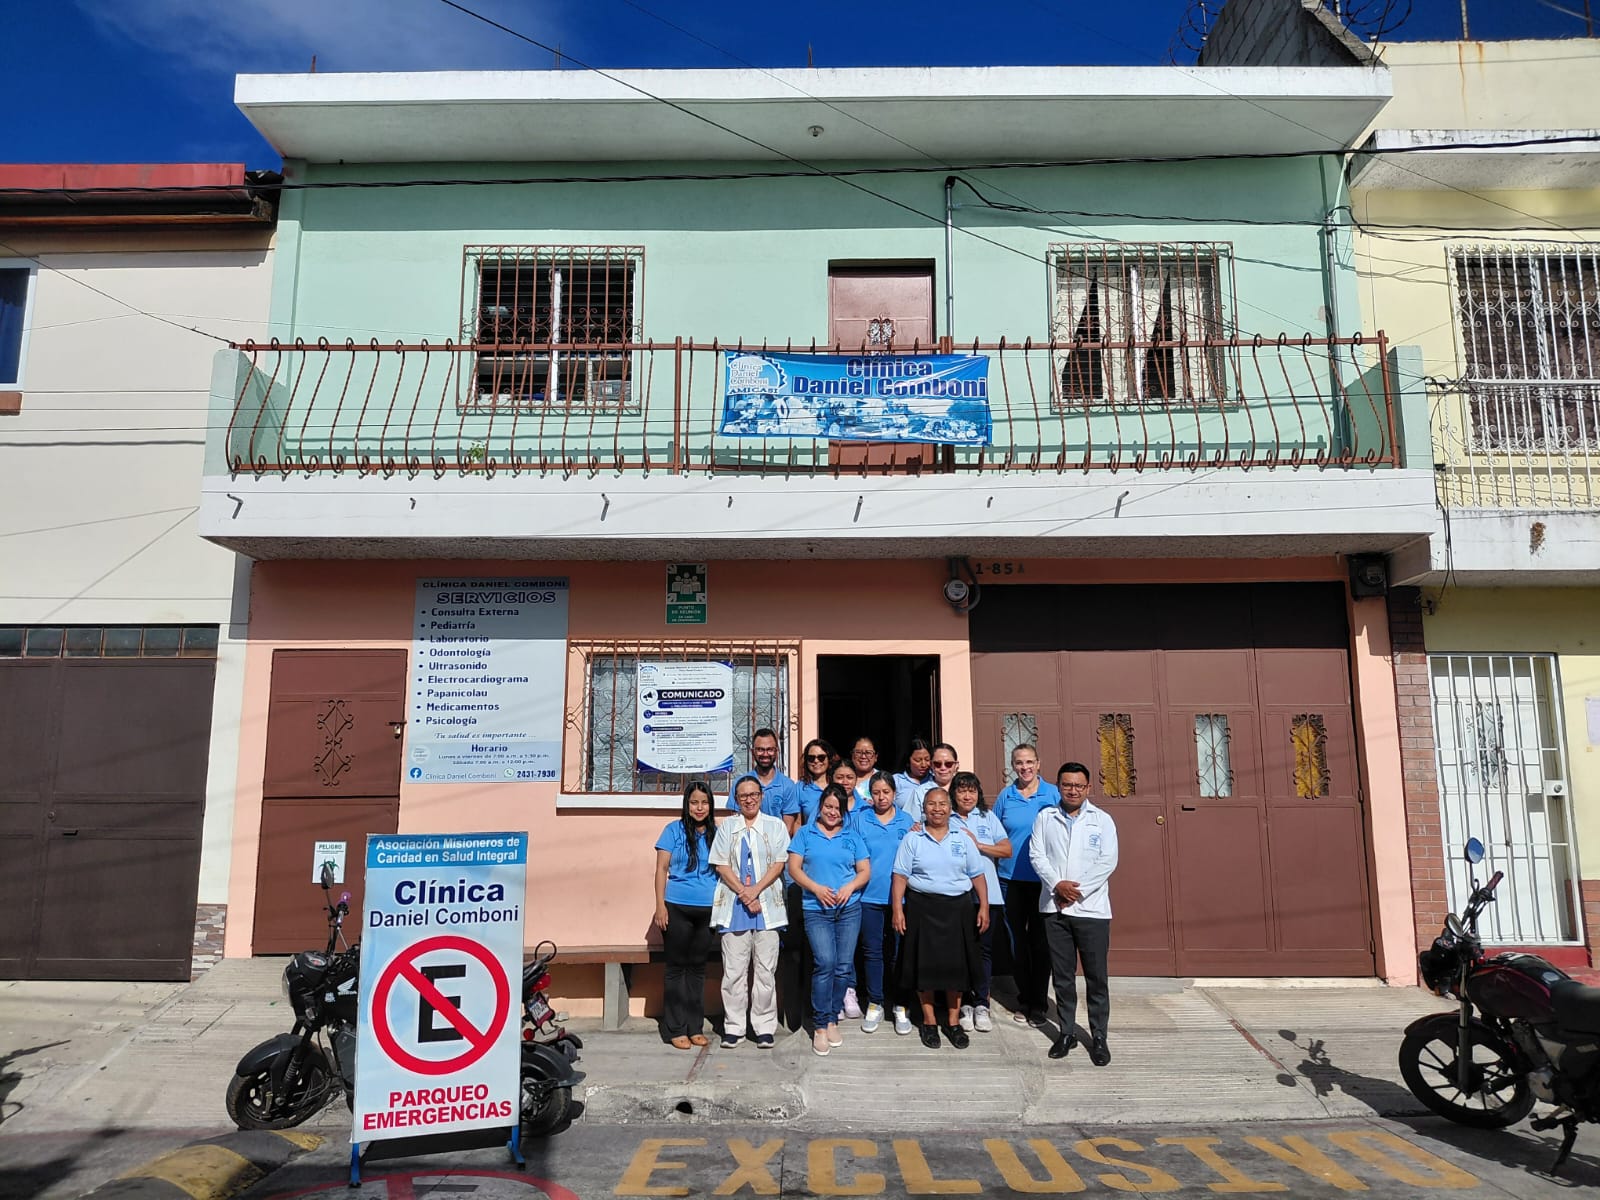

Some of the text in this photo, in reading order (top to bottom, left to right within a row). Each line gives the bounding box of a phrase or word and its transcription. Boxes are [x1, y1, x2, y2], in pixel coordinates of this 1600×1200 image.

[847, 357, 932, 378] Clínica
[793, 376, 986, 397] Daniel Comboni
[422, 580, 467, 588] CLÍNICA
[436, 591, 557, 604] SERVICIOS
[431, 607, 519, 616] Consulta Externa
[430, 620, 476, 630] Pediatría
[430, 634, 490, 643] Laboratorio
[429, 647, 491, 658] Odontología
[428, 661, 488, 670] Ultrasonido
[427, 674, 529, 685] Electrocardiograma
[427, 688, 488, 699] Papanicolau
[661, 690, 722, 699] COMUNICADO
[426, 702, 500, 711] Medicamentos
[425, 715, 477, 726] Psicología
[482, 732, 527, 740] importante
[471, 743, 508, 753] Horario
[446, 772, 467, 780] Daniel
[376, 836, 520, 850] Asociación Misioneros de
[376, 849, 518, 864] Caridad en Salud Integral
[394, 879, 505, 906] Clínica
[369, 905, 519, 928] Daniel Comboni
[389, 1083, 489, 1109] PARQUEO
[362, 1099, 512, 1131] EMERGENCIAS
[613, 1130, 1482, 1197] EXCLUSIVO
